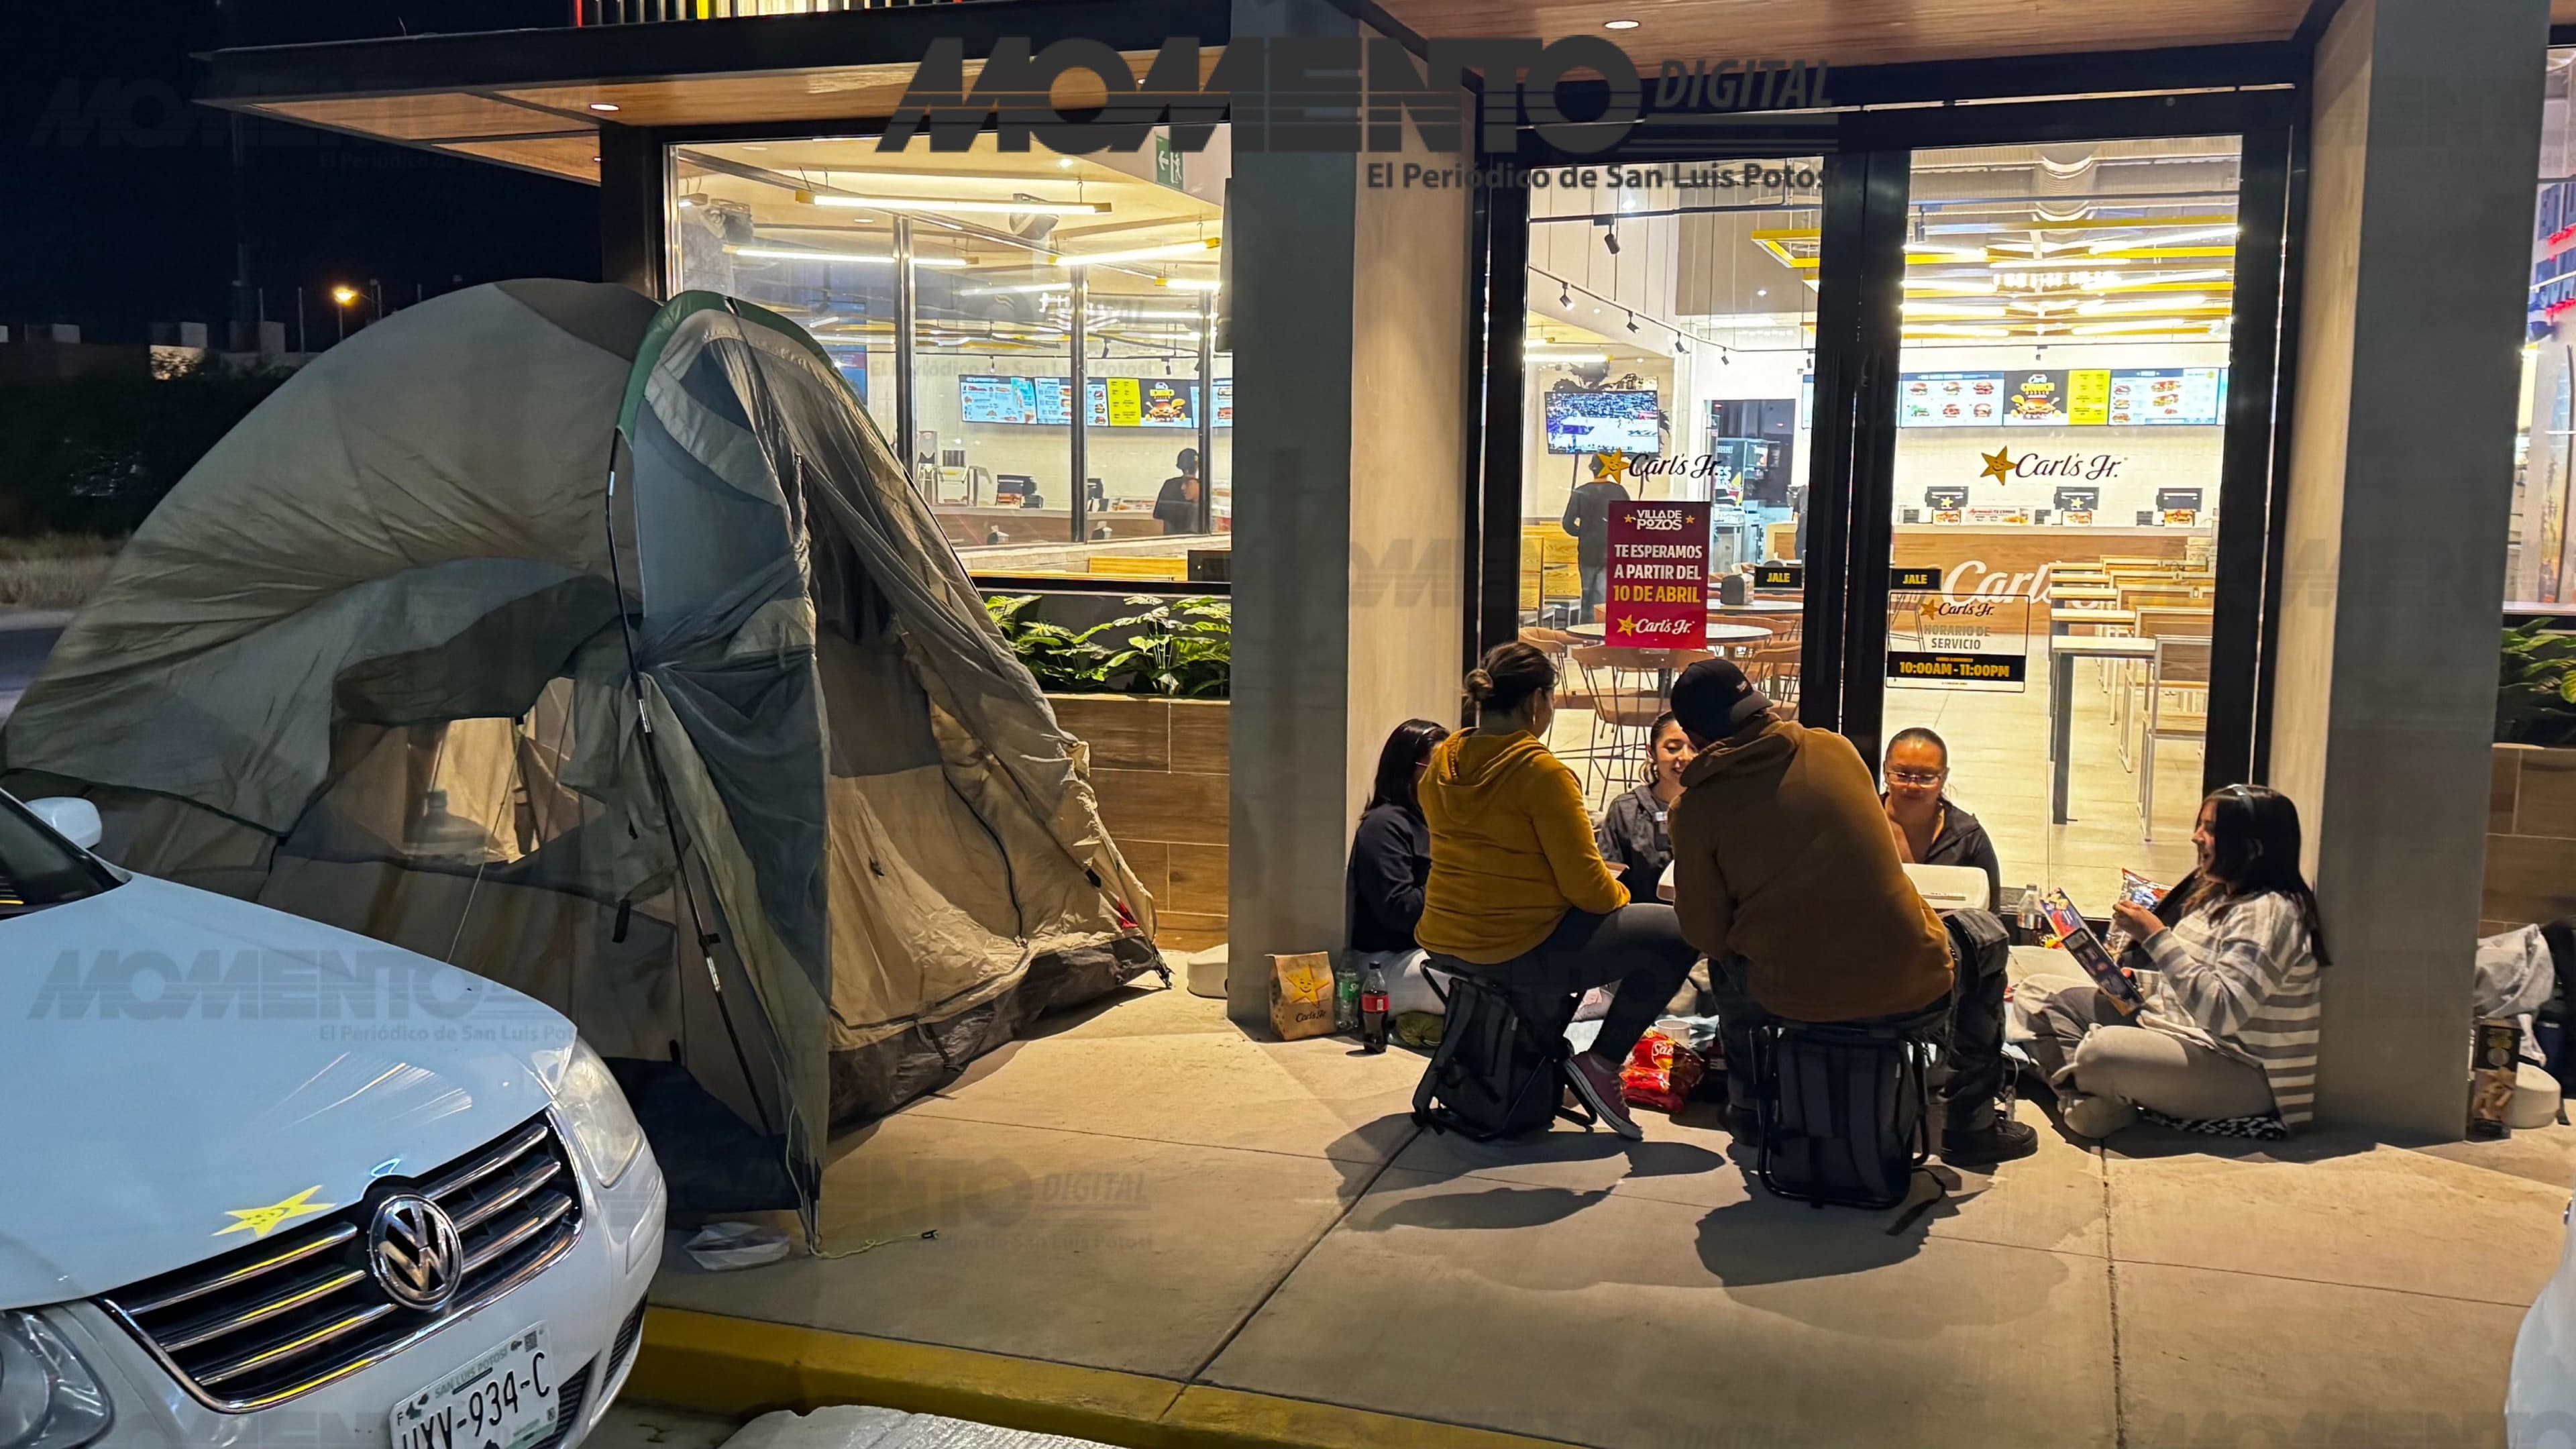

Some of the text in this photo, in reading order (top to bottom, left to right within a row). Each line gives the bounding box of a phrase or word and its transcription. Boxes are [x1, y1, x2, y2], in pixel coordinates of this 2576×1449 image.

[1628, 453, 1722, 479] Carl's Jr.
[2015, 452, 2122, 481] Carl's Jr.
[1637, 509, 1682, 519] VILLA DE
[1614, 544, 1703, 559] TE ESPERAMOS
[1614, 564, 1702, 580] A PARTIR DEL
[1766, 572, 1791, 583] JALE
[1902, 574, 1928, 585] JALE
[1613, 585, 1701, 603] 10 DE ABRIL
[1938, 602, 1995, 617] Carl's Jr.
[1635, 619, 1691, 635] Carl's Jr.
[1923, 625, 1991, 637] HORARIO DE
[1931, 637, 1981, 650] SERVICIO
[1900, 661, 1953, 676] 10:00AM
[1960, 663, 2010, 678] 11:00PM
